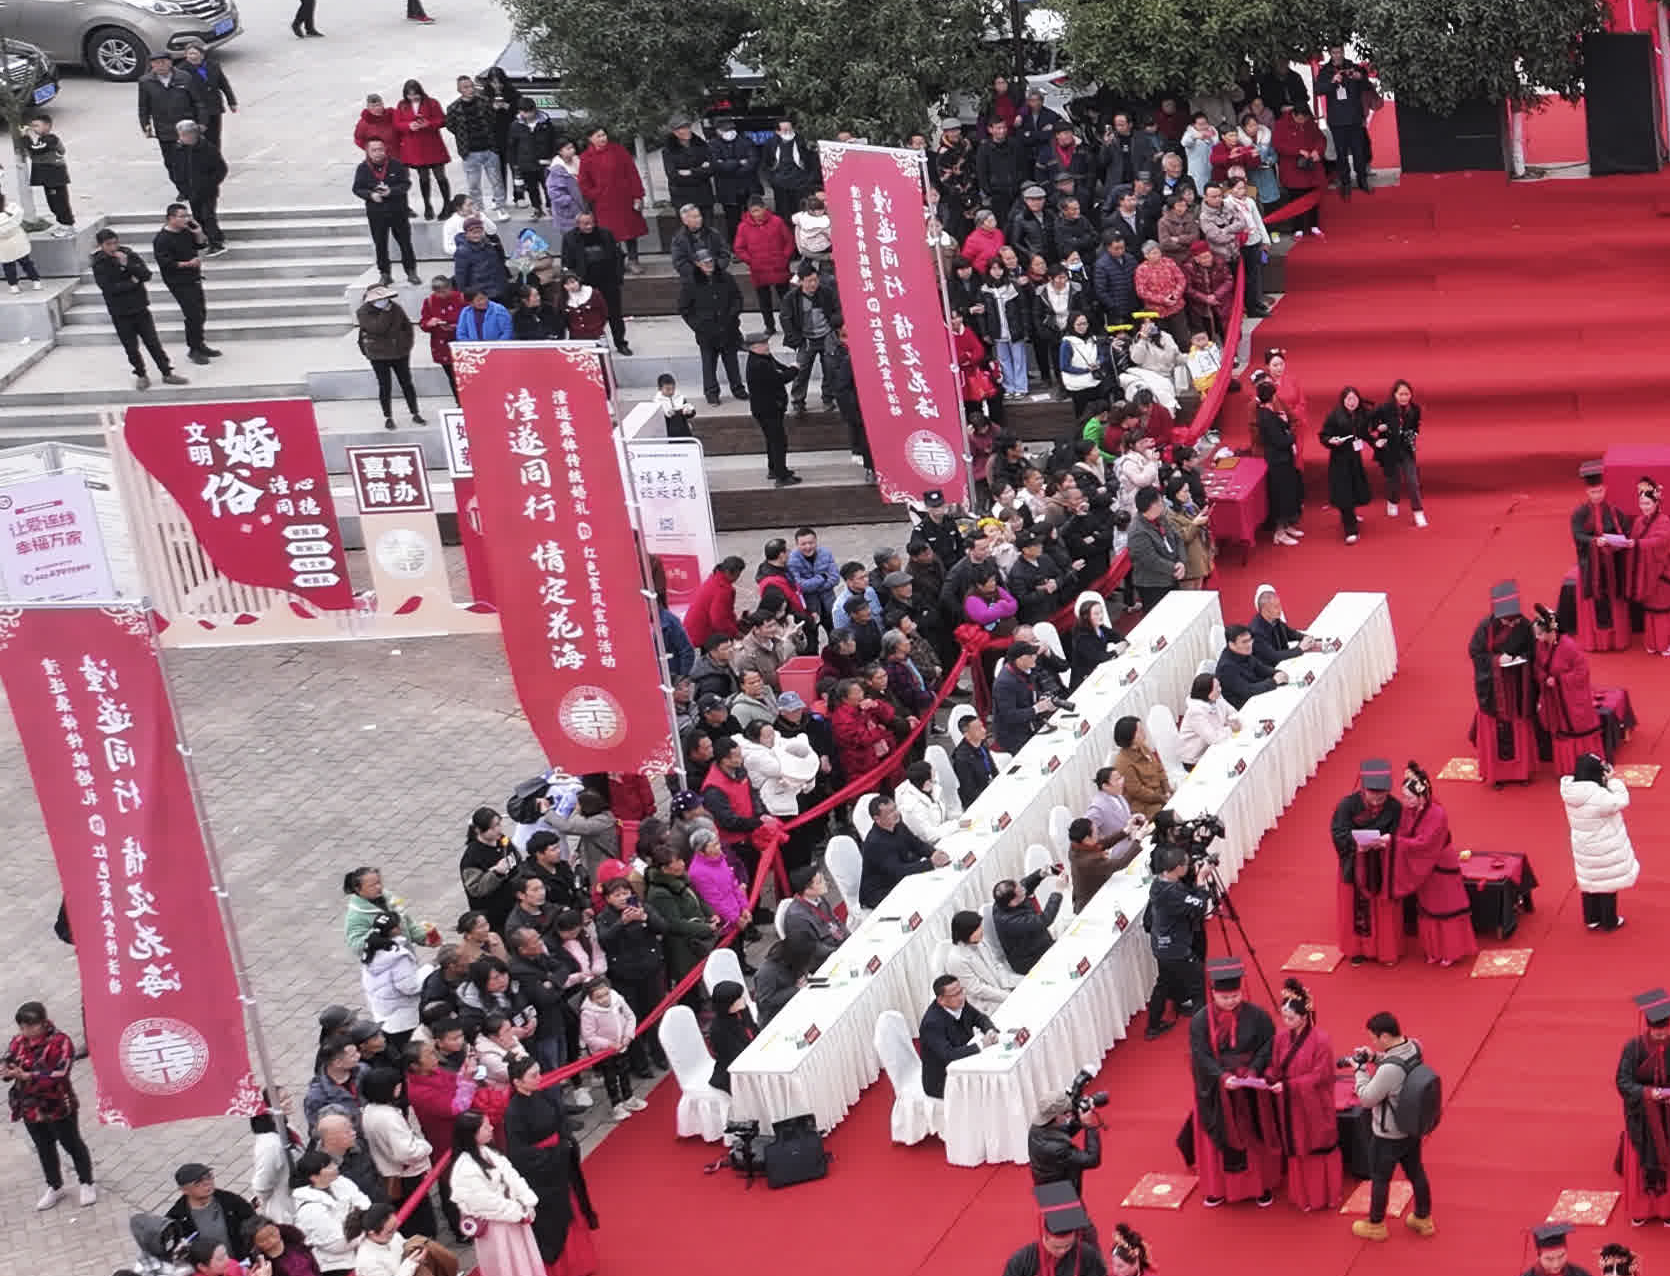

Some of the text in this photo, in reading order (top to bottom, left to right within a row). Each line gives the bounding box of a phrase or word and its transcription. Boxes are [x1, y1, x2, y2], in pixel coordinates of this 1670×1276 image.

[184, 422, 214, 466] 文明
[201, 416, 282, 519] 婚俗
[360, 455, 414, 478] 喜事
[276, 497, 321, 516] 同德
[366, 480, 419, 504] 简办
[504, 387, 586, 670] 潼遂同行 情定花海
